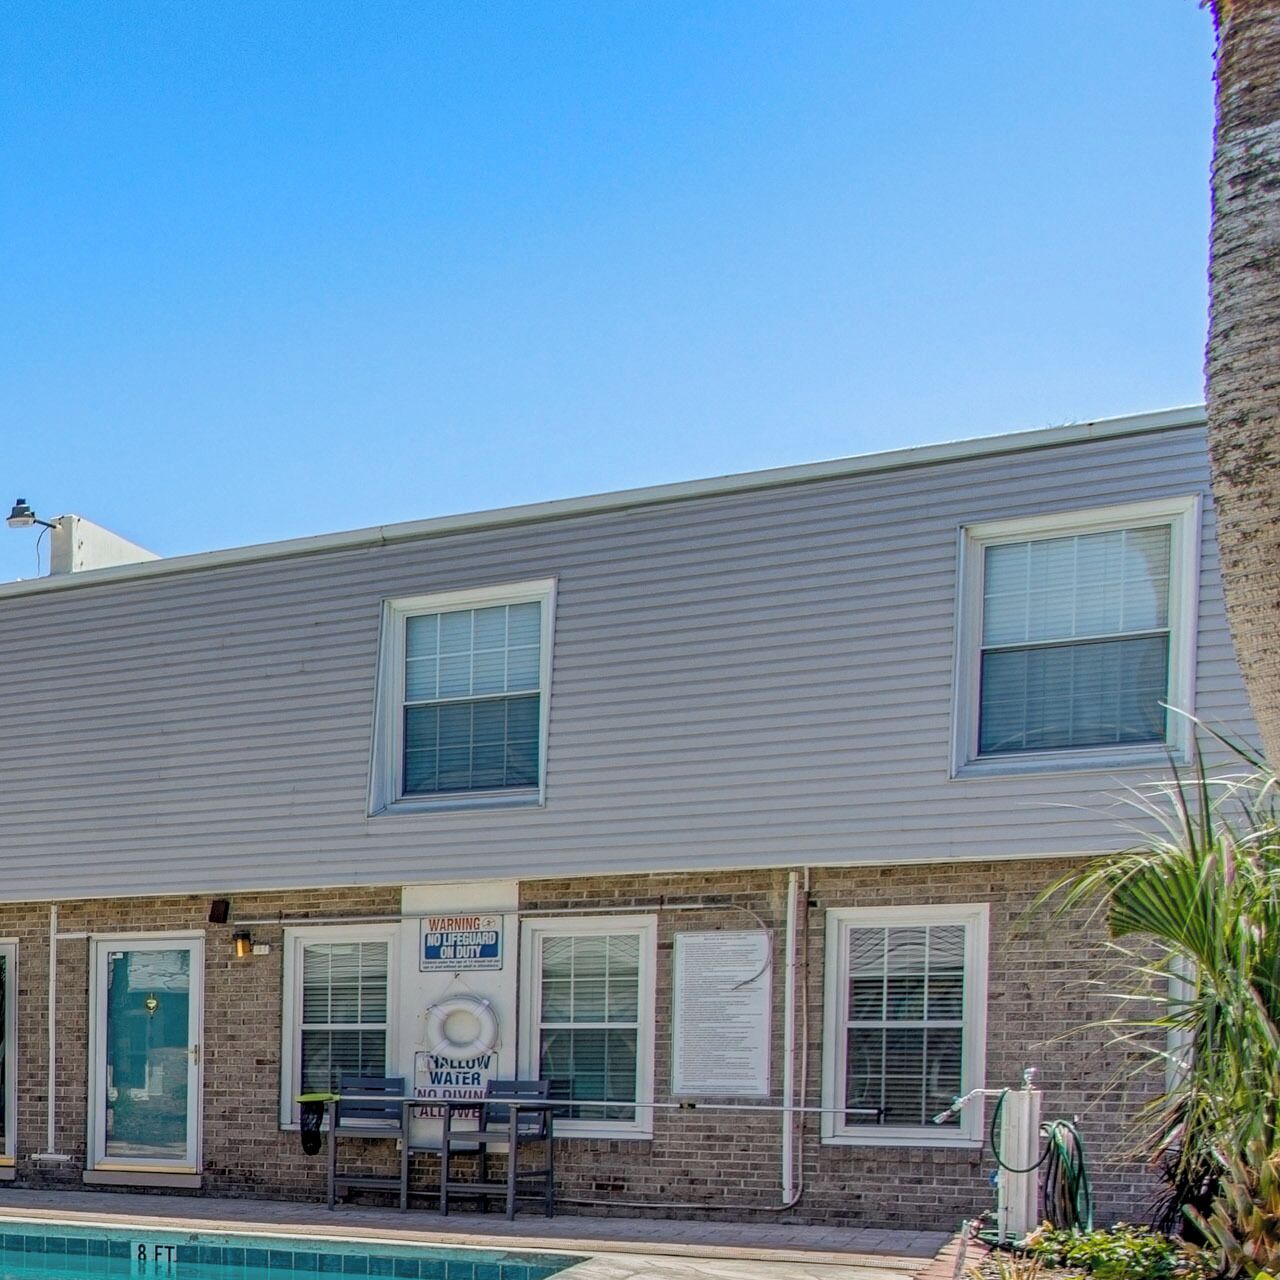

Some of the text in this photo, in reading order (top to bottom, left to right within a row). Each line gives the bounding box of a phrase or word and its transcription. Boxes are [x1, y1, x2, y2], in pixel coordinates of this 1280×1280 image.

[429, 917, 480, 931] WARNING
[427, 932, 496, 946] NO LIFEGUARD
[440, 945, 481, 958] ON DUTY
[430, 1072, 481, 1085] WATER
[443, 1089, 485, 1099] DIVIN
[138, 1244, 175, 1262] 8 FT
